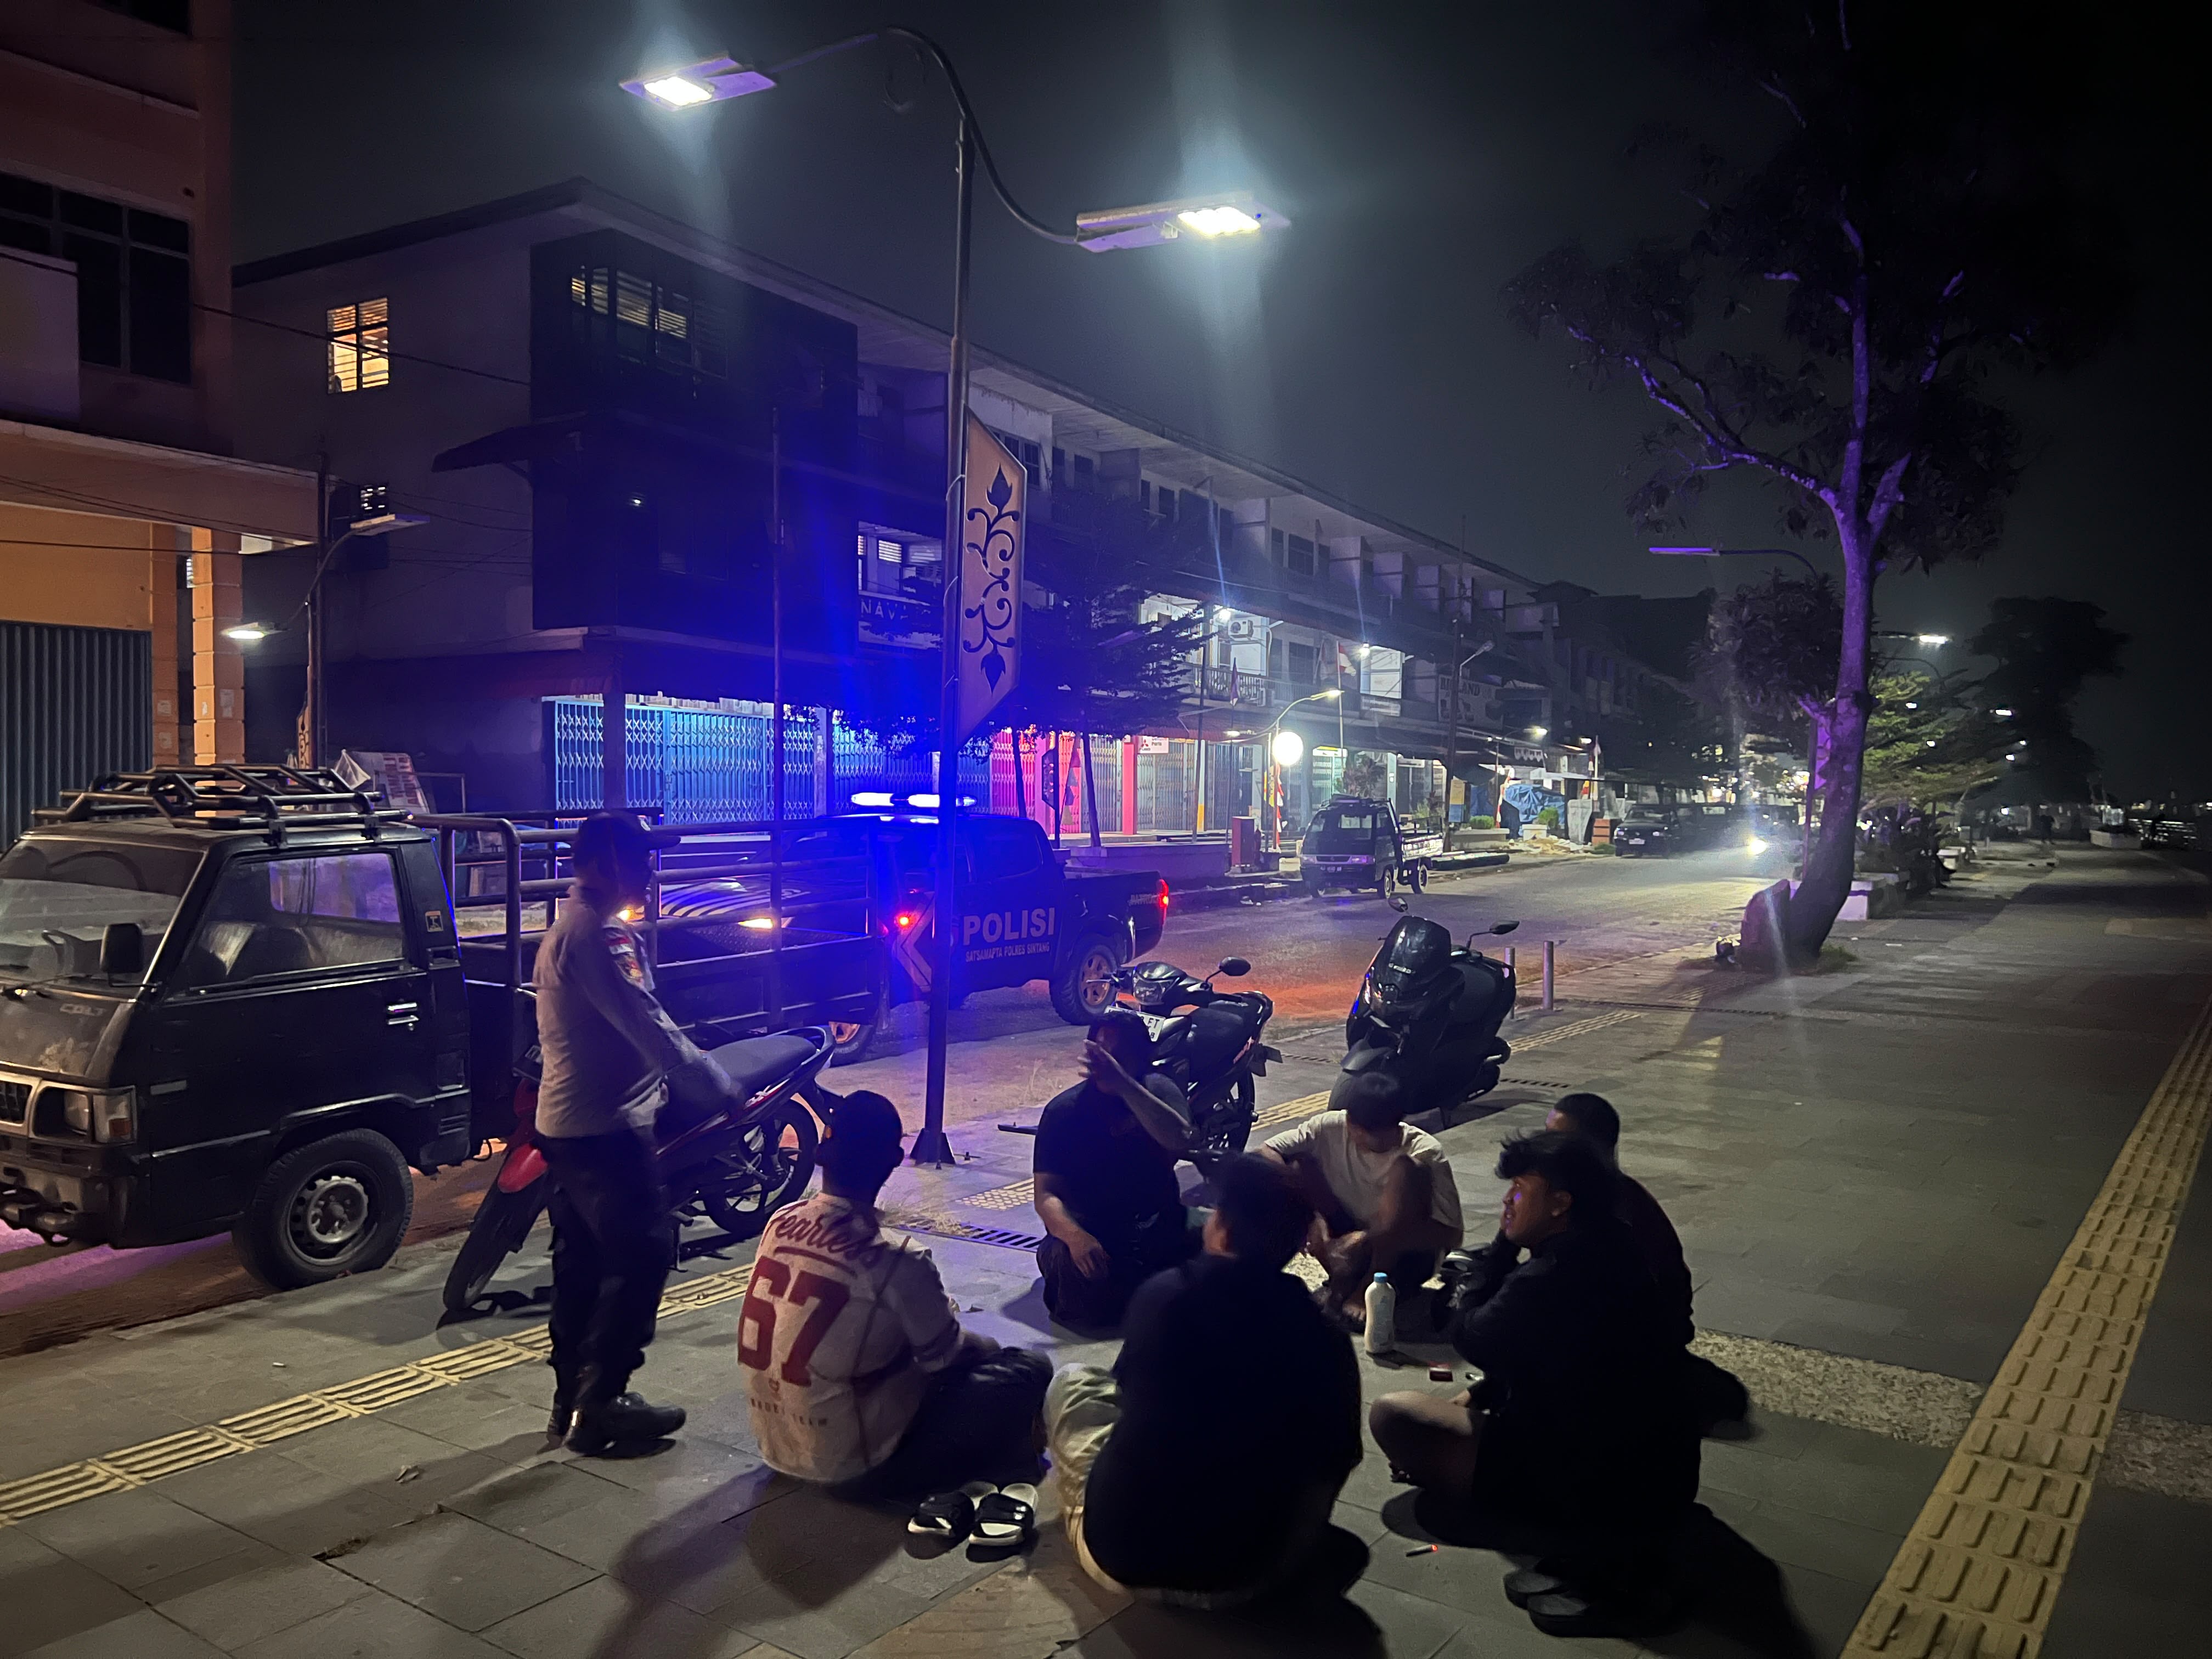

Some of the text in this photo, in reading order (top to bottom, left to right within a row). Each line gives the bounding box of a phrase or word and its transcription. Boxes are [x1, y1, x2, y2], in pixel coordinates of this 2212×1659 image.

[963, 907, 1056, 946] POLISI
[966, 941, 1050, 963] SATSAMAPTA POLRES SINTANG
[738, 1255, 850, 1387] 67
